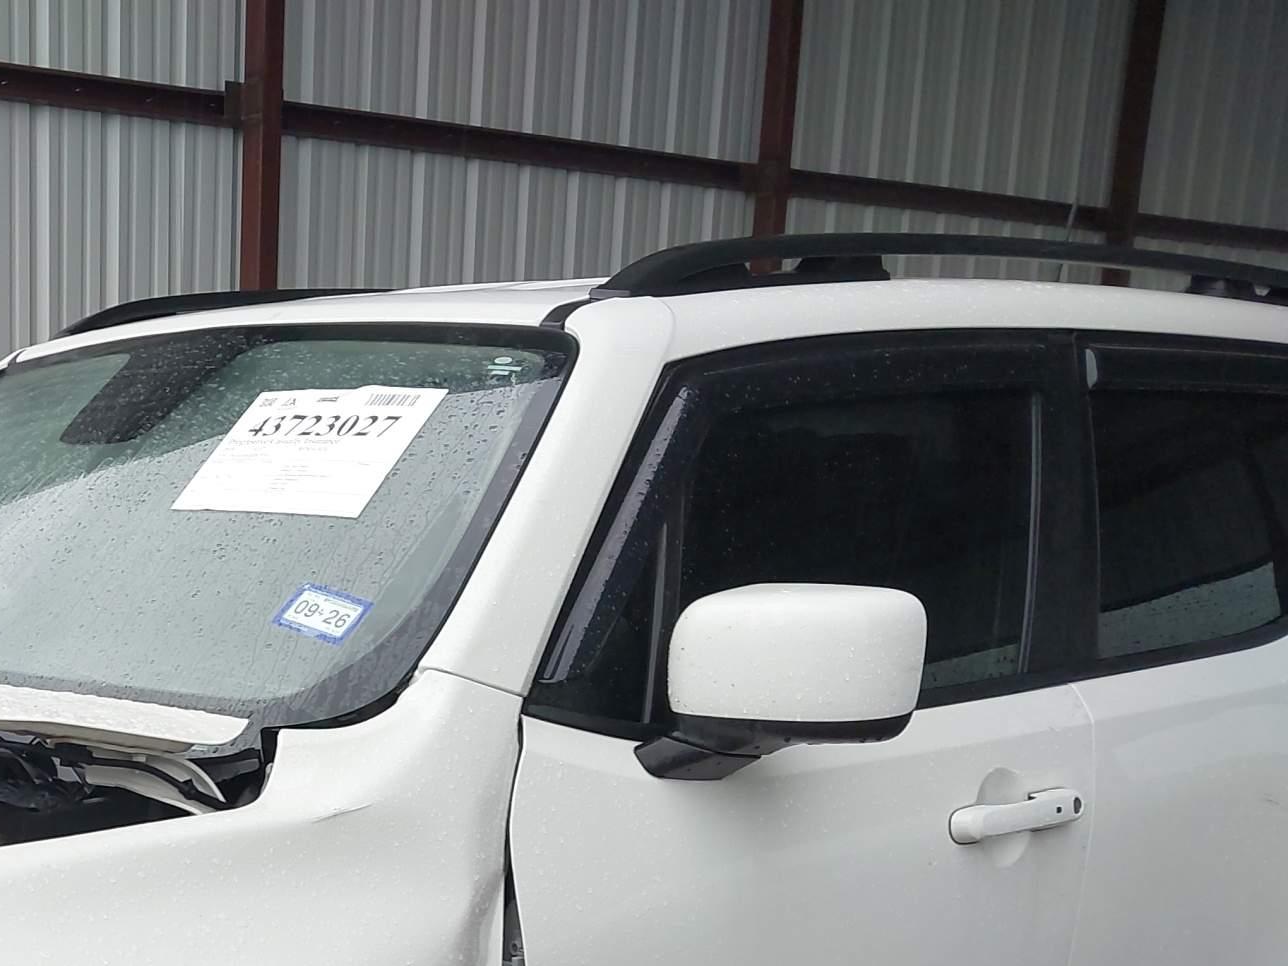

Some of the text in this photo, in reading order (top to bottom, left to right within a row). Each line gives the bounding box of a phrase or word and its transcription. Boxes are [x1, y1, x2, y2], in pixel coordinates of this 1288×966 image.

[248, 414, 403, 437] 43723027
[293, 599, 351, 629] 09 26
